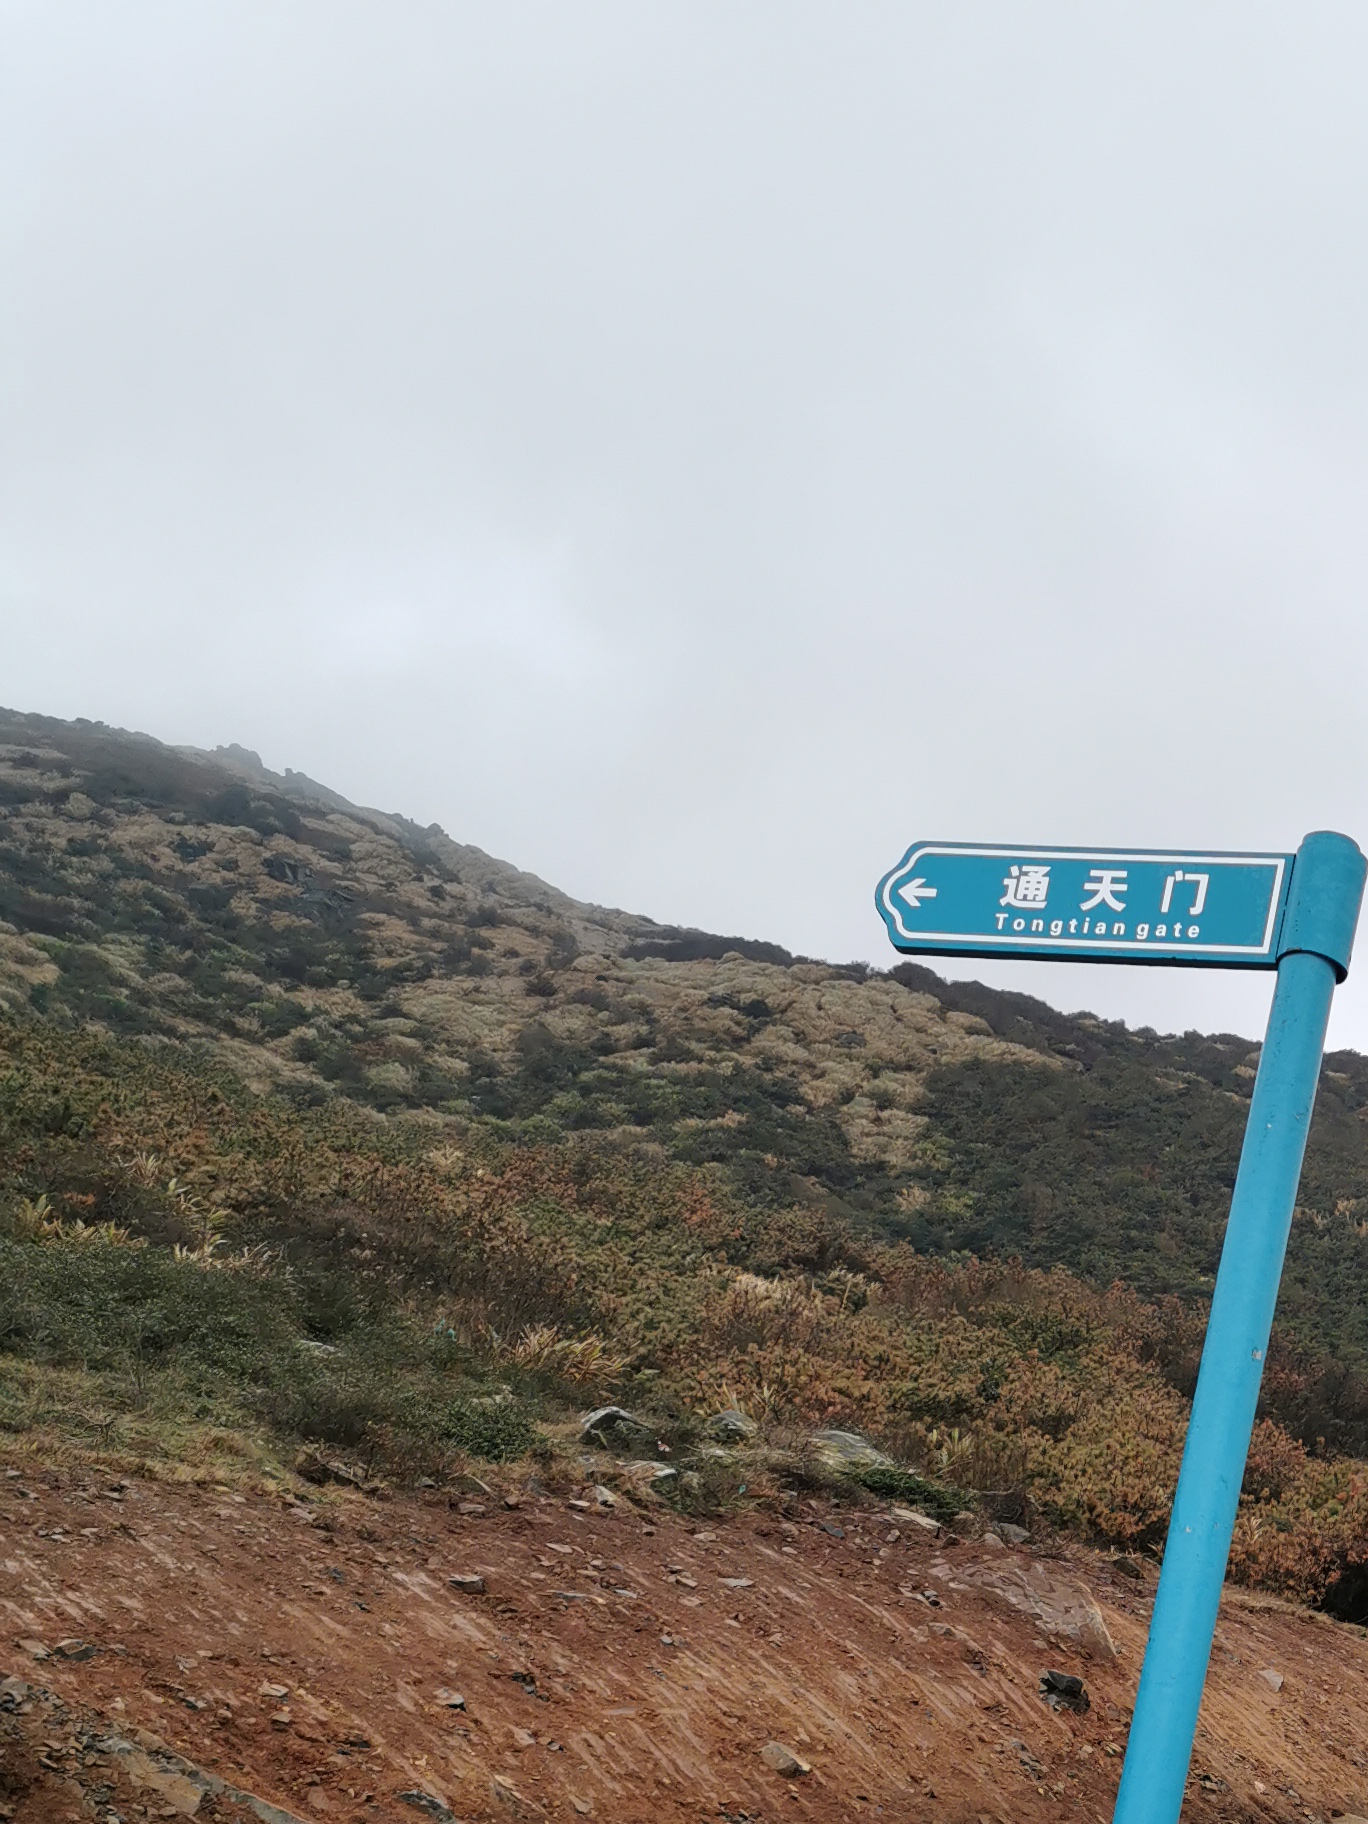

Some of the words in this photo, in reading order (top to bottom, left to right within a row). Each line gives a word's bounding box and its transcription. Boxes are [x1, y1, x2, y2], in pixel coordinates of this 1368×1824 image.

[999, 865, 1210, 916] 通天门
[995, 913, 1126, 937] Tongtian
[1136, 922, 1201, 940] gate
